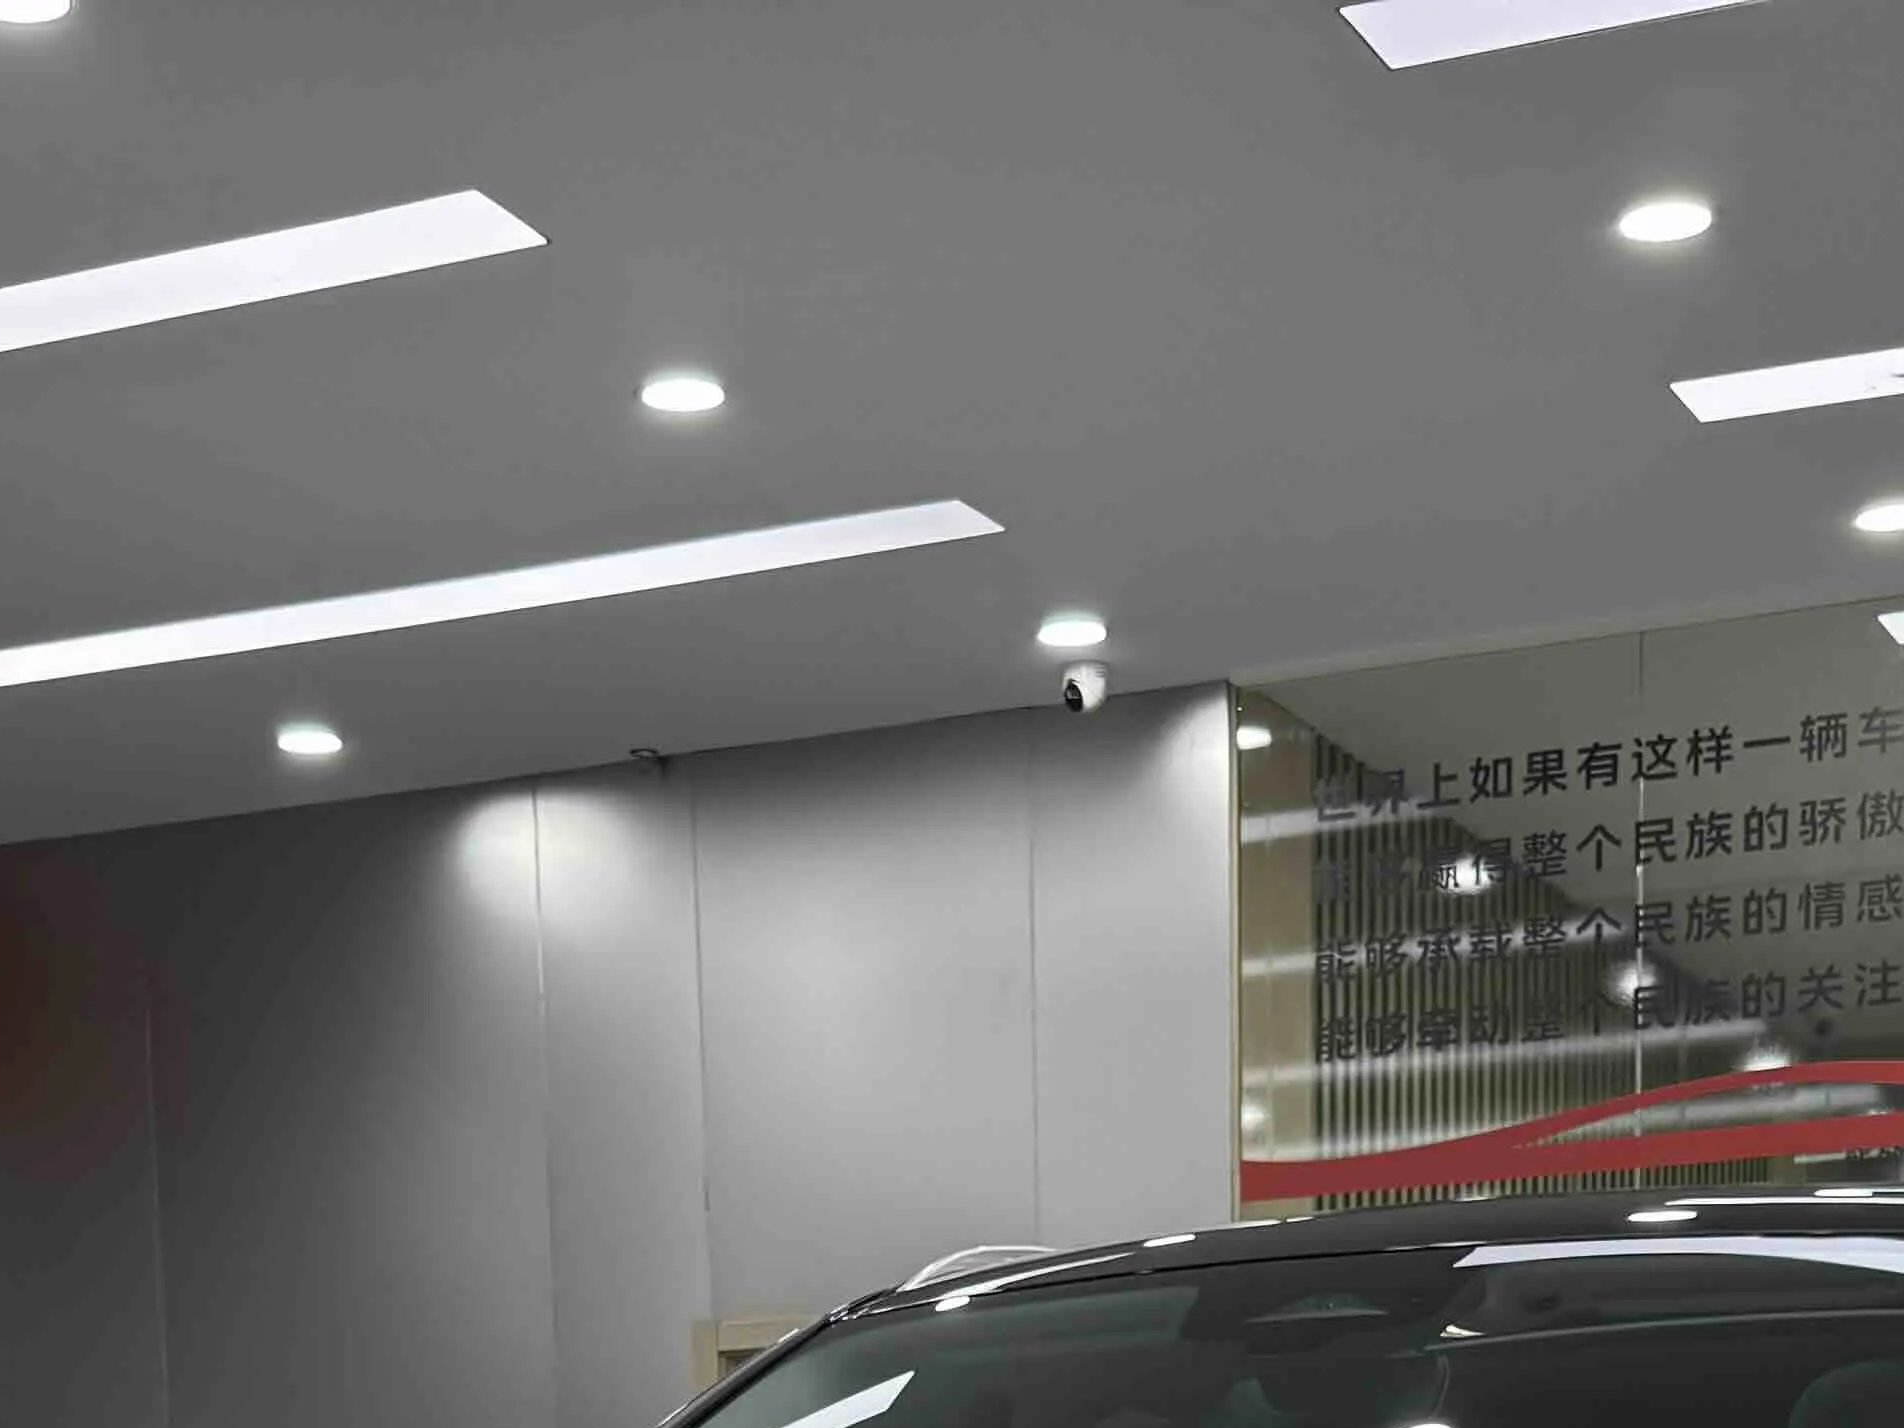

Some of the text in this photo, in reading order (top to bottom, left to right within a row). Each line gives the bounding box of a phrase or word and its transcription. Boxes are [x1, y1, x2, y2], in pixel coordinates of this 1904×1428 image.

[1315, 788, 1904, 905] 赢得整个民族的骄傲
